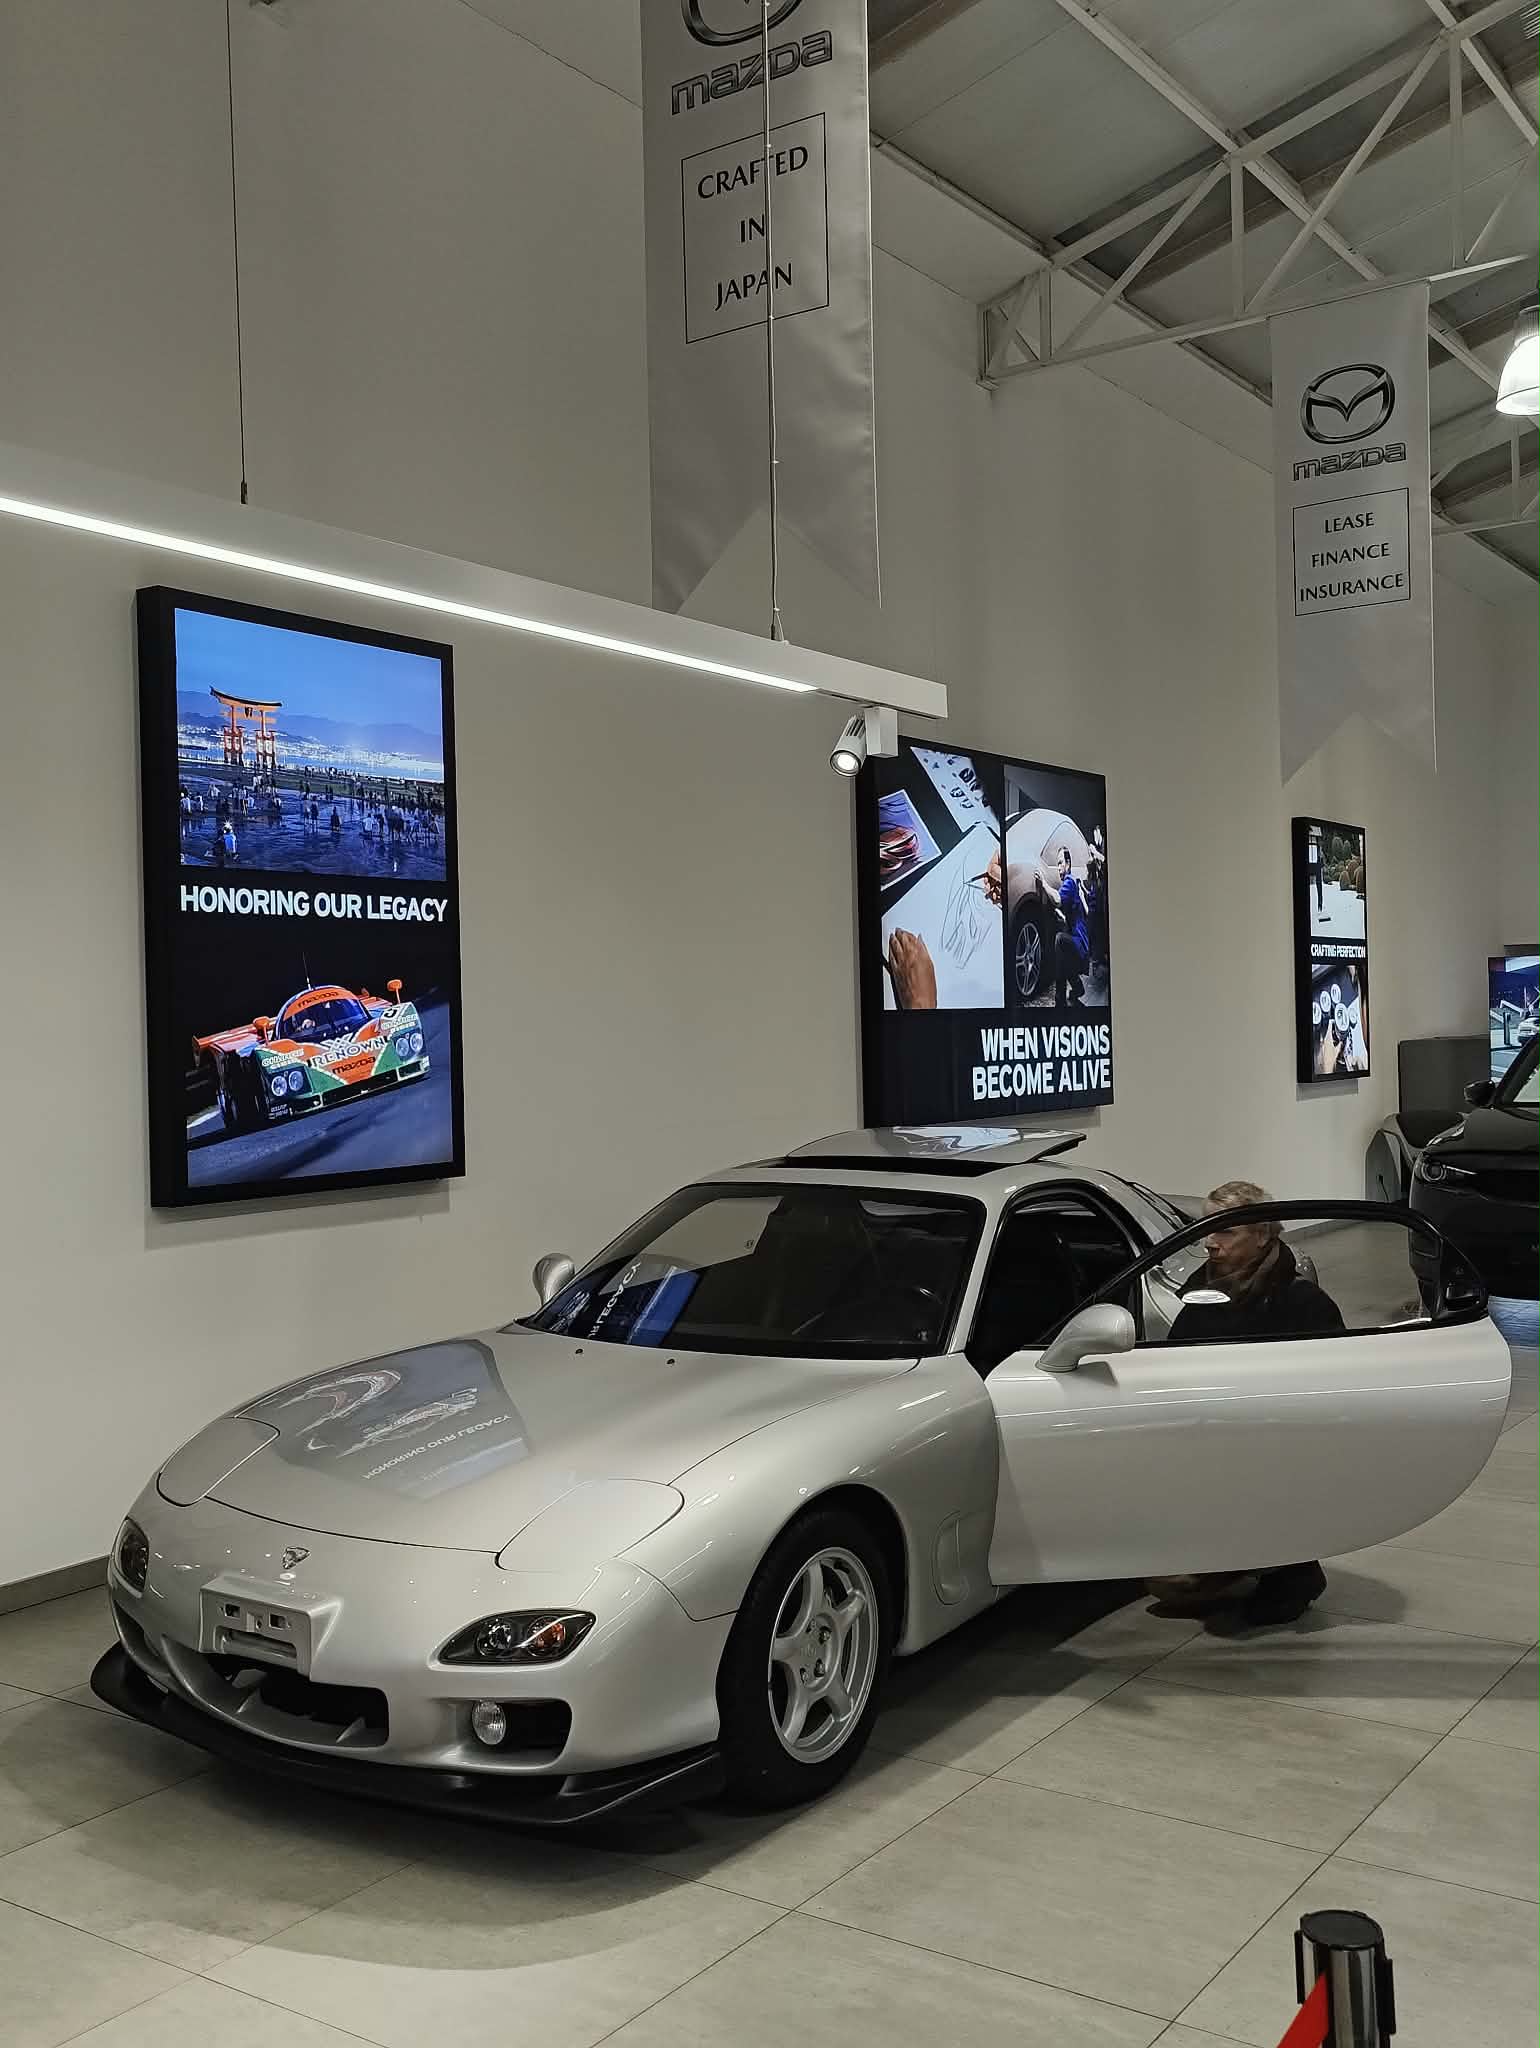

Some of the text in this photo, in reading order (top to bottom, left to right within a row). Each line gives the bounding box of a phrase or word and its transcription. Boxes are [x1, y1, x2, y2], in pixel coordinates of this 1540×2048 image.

[672, 29, 833, 116] mazda
[740, 213, 767, 243] IN
[715, 262, 792, 311] JAPAN
[1293, 442, 1407, 481] mazda
[1324, 512, 1375, 533] LEASE
[1311, 542, 1390, 568] FINANCE
[1300, 573, 1404, 601] INSURANCE
[180, 885, 448, 922] HONORING OUR LEGACY
[1311, 943, 1366, 959] CRAFTING PERFECTION
[312, 1036, 385, 1068] RENOWN
[981, 1024, 1110, 1061] WHEN VISIONS
[973, 1059, 1111, 1101] BECOME ALIVE
